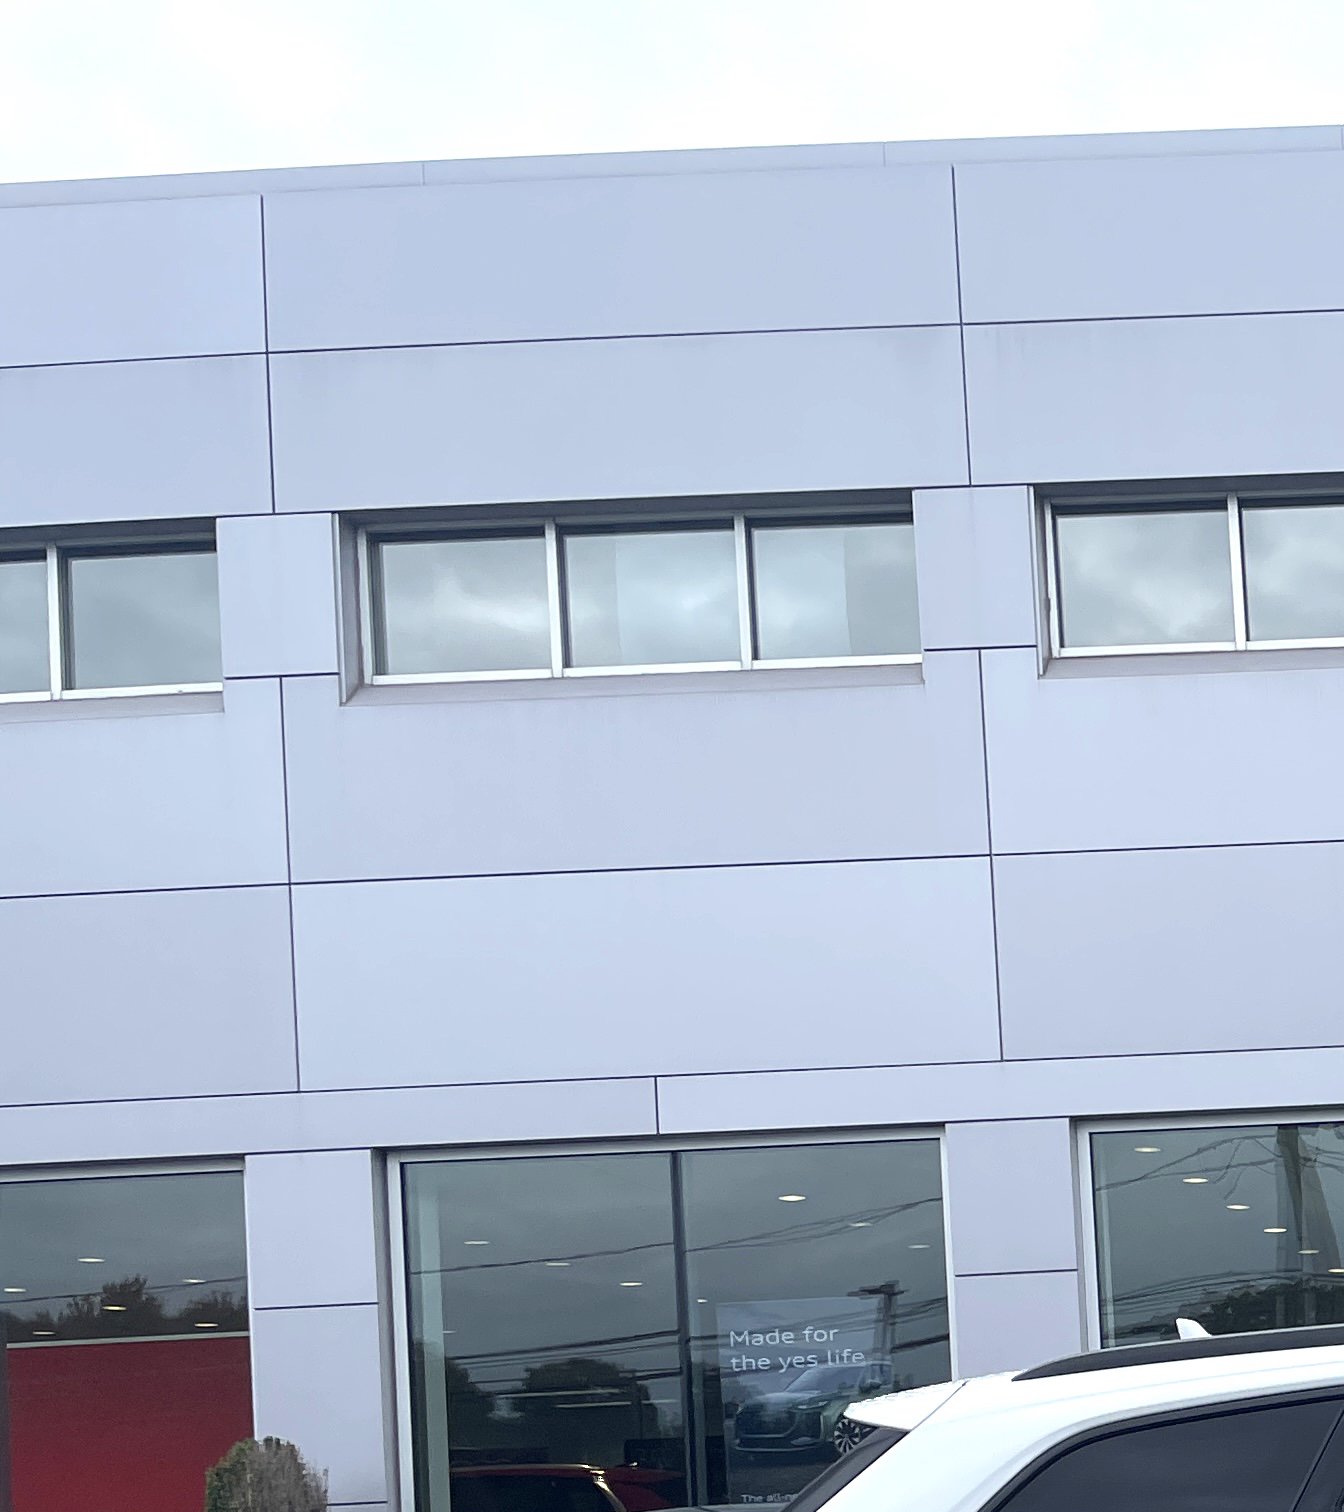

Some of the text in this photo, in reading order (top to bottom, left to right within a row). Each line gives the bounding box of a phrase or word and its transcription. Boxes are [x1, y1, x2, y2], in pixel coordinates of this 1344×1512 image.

[729, 1326, 839, 1347] Made for
[730, 1349, 865, 1373] the yes life
